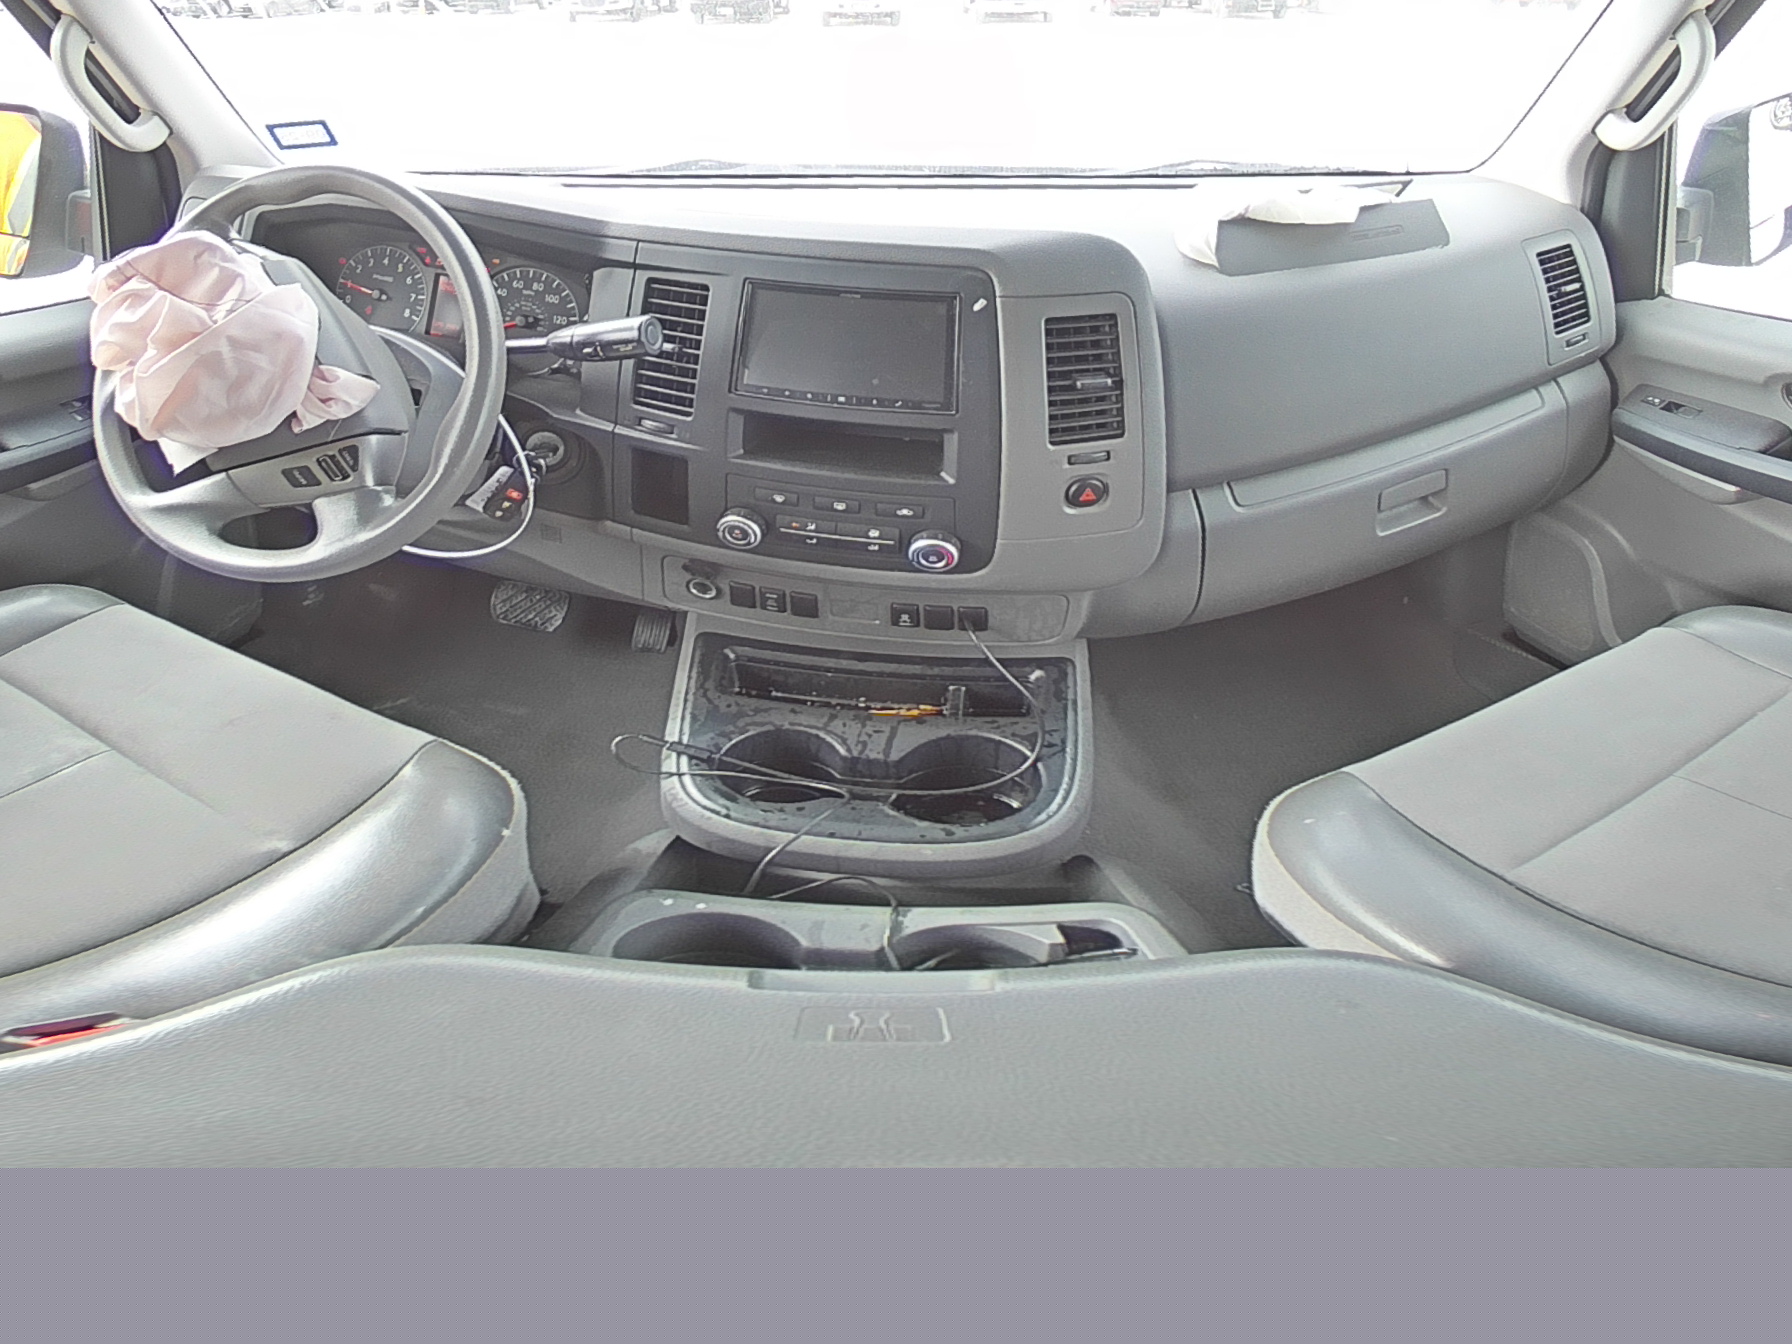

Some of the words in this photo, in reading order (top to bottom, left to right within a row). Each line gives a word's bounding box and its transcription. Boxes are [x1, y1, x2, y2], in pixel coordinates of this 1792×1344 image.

[368, 258, 374, 267] 3
[382, 257, 389, 266] 4
[356, 264, 363, 273] 2
[397, 263, 404, 272] 5
[406, 276, 413, 285] 6
[512, 280, 524, 289] 60
[532, 281, 545, 291] 80
[497, 288, 508, 296] 40
[345, 295, 351, 304] 0
[410, 293, 417, 303] 7
[545, 294, 560, 304] 100
[403, 308, 411, 318] 8
[553, 315, 568, 325] 120
